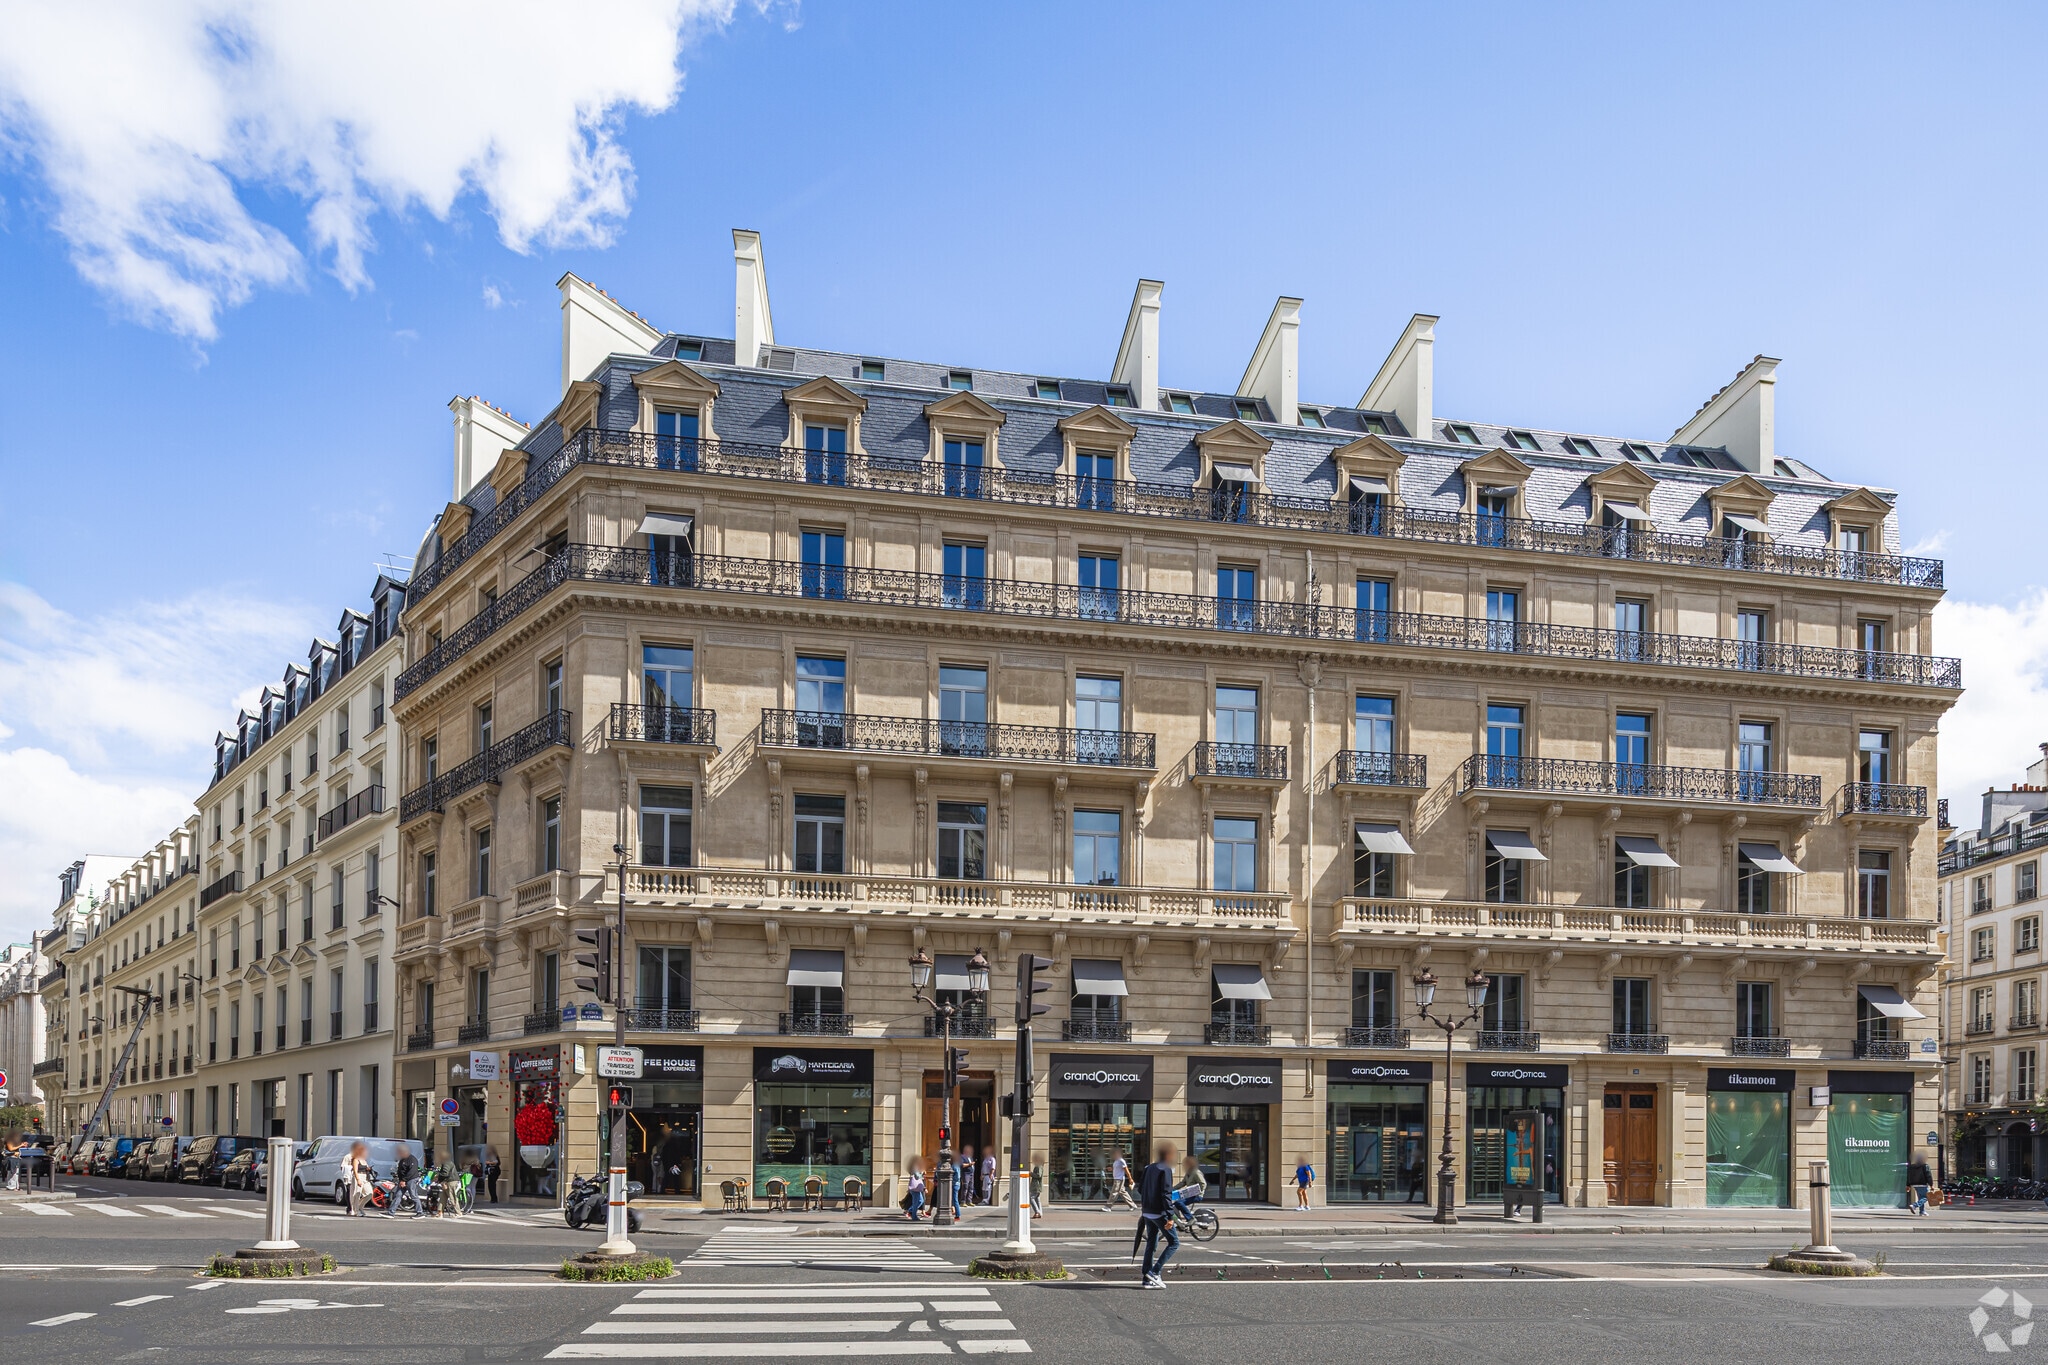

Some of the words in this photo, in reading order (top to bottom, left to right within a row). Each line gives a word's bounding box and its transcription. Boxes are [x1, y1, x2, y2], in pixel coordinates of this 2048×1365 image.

[521, 1060, 538, 1068] COFFEE
[538, 1058, 553, 1067] HOUSE
[643, 1059, 662, 1067] FEE
[663, 1059, 696, 1067] HOUSE
[1728, 1073, 1776, 1085] tikamoon
[1845, 1137, 1890, 1147] tikamoon
